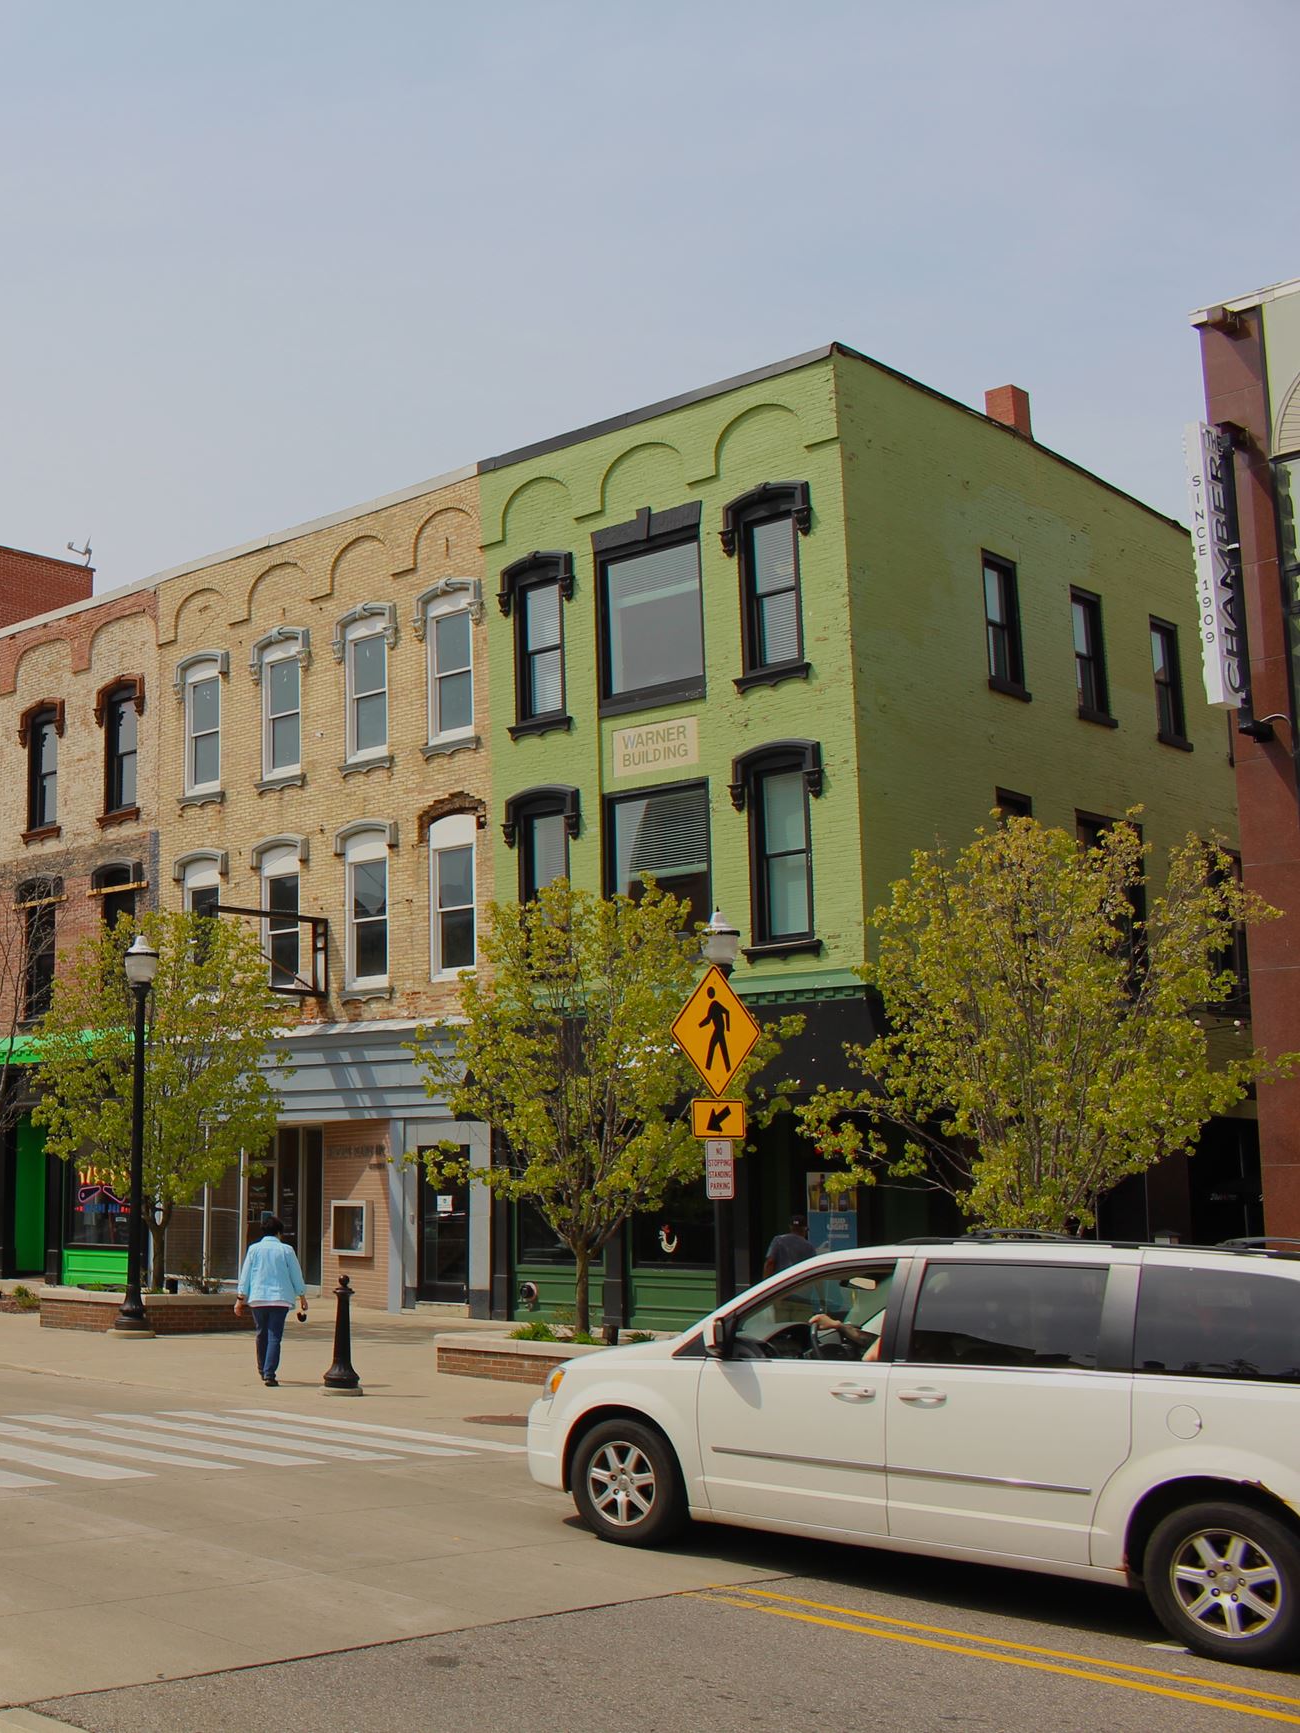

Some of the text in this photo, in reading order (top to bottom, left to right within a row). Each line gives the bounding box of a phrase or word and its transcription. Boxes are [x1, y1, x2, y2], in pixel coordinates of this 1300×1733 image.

[1191, 474, 1216, 644] SINCE 1909
[1208, 455, 1245, 694] CHAMBER
[622, 724, 687, 750] WARNER
[622, 742, 689, 768] BUILDING
[715, 1147, 723, 1155] NO
[708, 1159, 732, 1167] STOPPING
[708, 1170, 732, 1178] STANDING
[710, 1182, 731, 1190] PARKING
